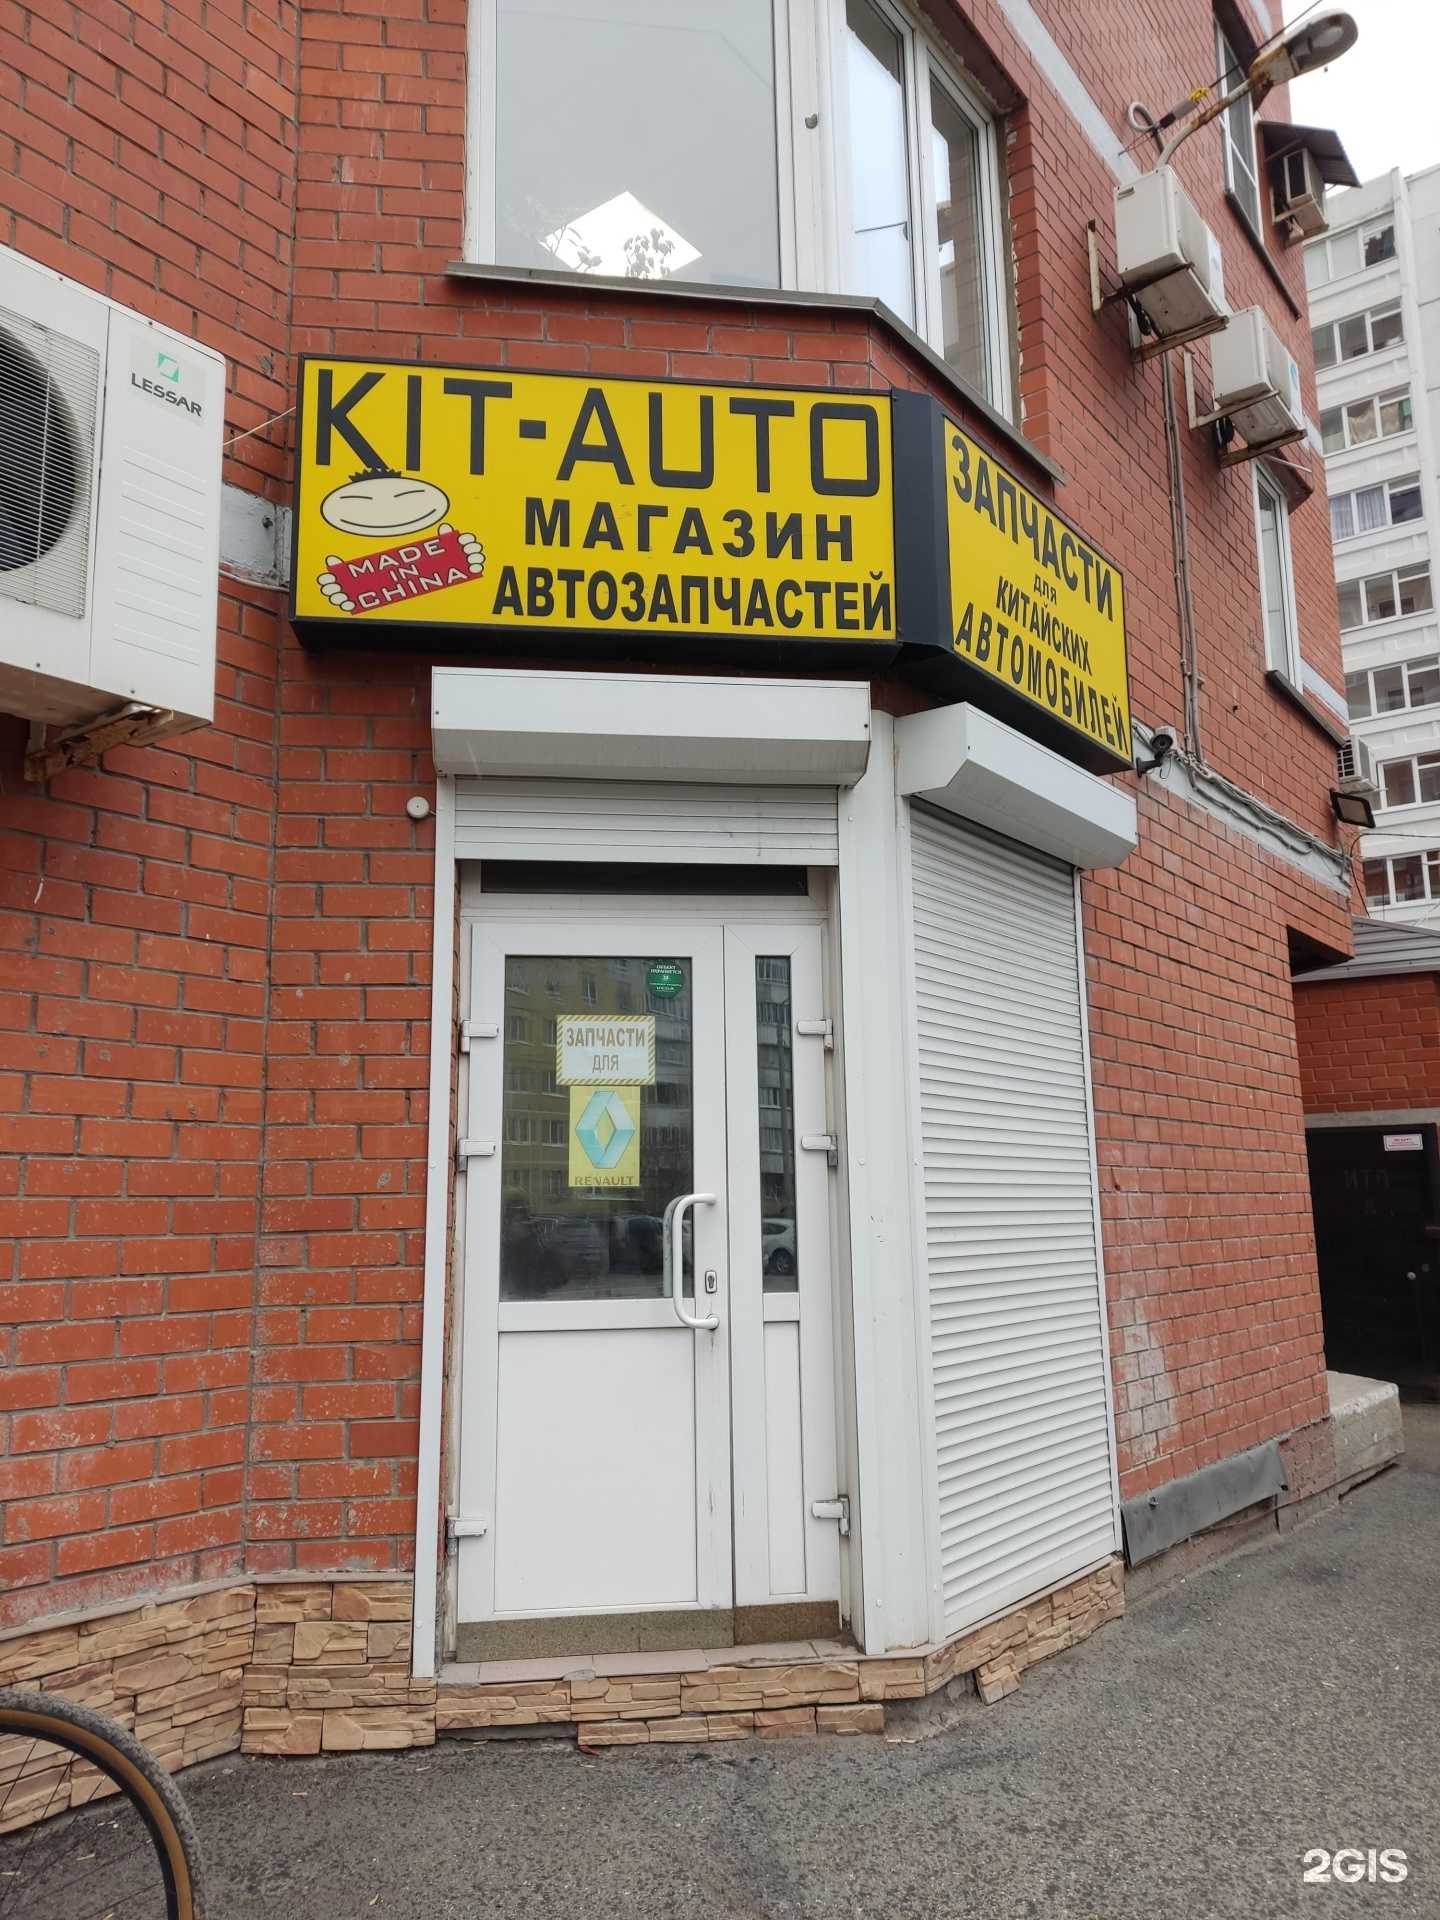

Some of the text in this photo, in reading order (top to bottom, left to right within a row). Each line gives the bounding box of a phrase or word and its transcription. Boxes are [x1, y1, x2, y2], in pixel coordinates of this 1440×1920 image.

[131, 372, 202, 417] LESSAR
[316, 368, 880, 498] KIT-AUTO
[524, 497, 854, 562] МАГАЗИН
[952, 435, 1114, 621] ЗАПЧАСТИ
[348, 538, 445, 578] MADE
[389, 564, 420, 582] IN
[358, 567, 468, 609] CHINA
[492, 566, 892, 632] АВТОЗАПЧАСТЕЙ
[996, 576, 1092, 675] КИТАЙСКИХ
[955, 602, 1129, 755] АВТОМОБИЛЕЙ
[566, 1027, 646, 1048] ЗАПЧАСТИ
[592, 1054, 619, 1074] ДЛЯ
[574, 1175, 634, 1186] RENAULT
